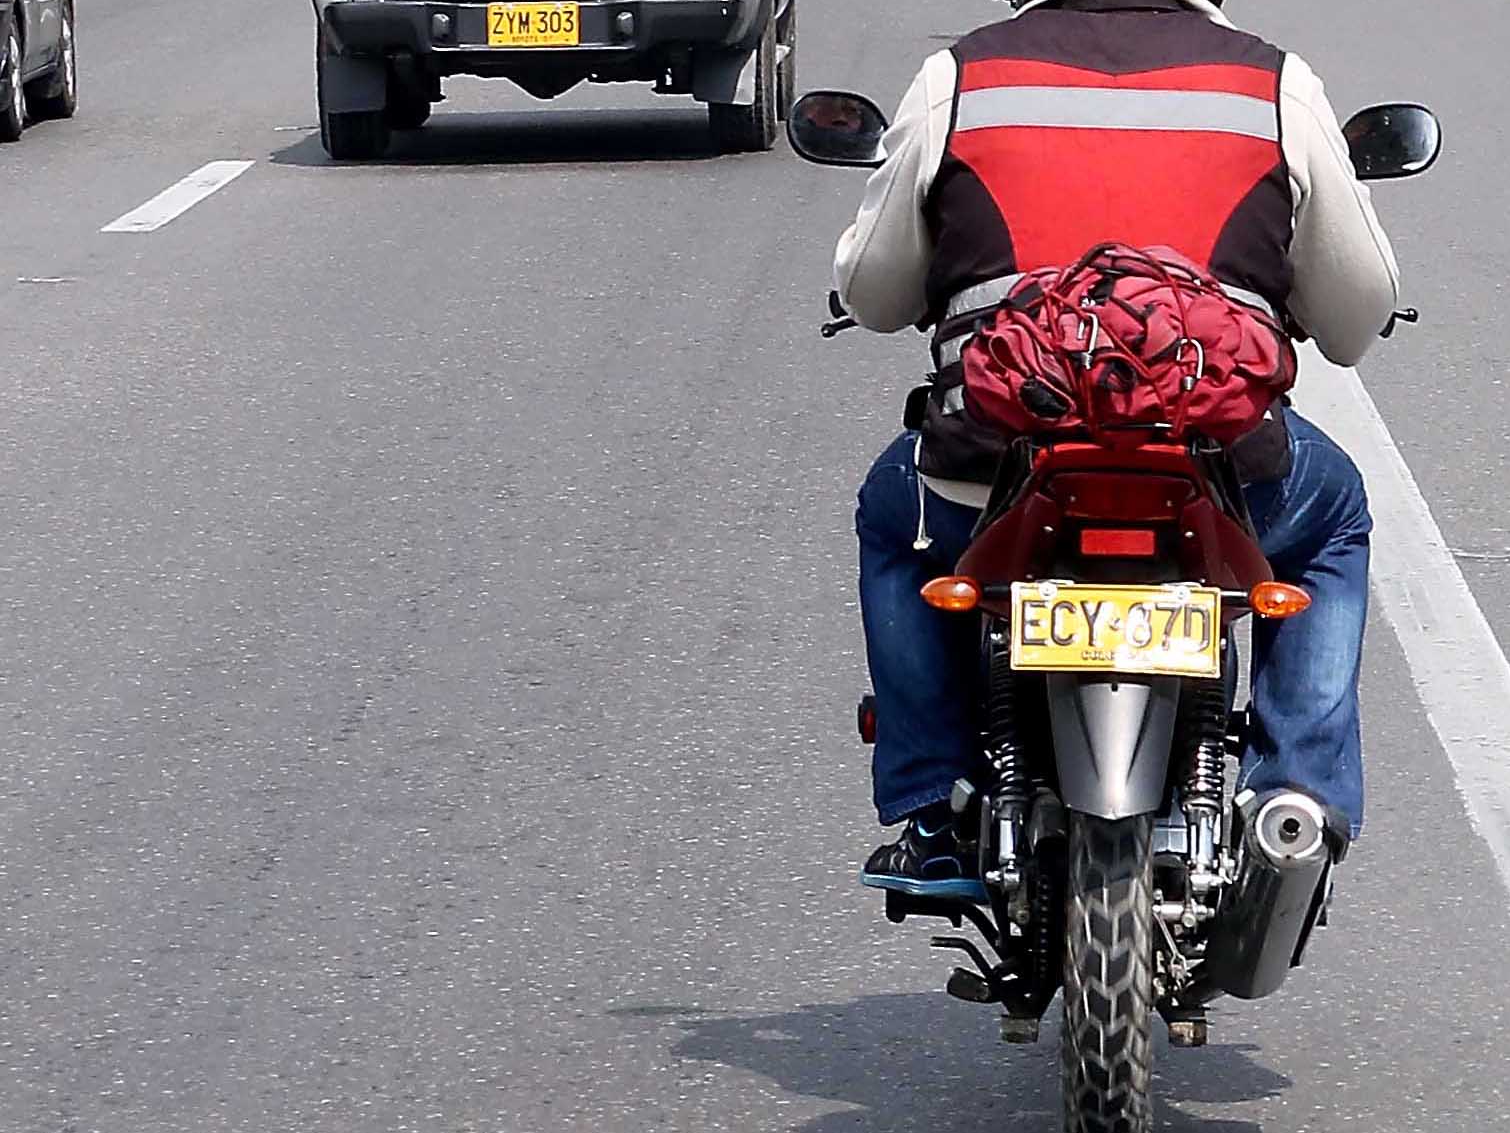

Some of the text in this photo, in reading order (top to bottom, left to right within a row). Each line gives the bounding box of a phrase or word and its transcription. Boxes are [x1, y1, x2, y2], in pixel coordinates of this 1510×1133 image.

[493, 10, 574, 34] ZYM 303
[1021, 599, 1103, 647] ECY
